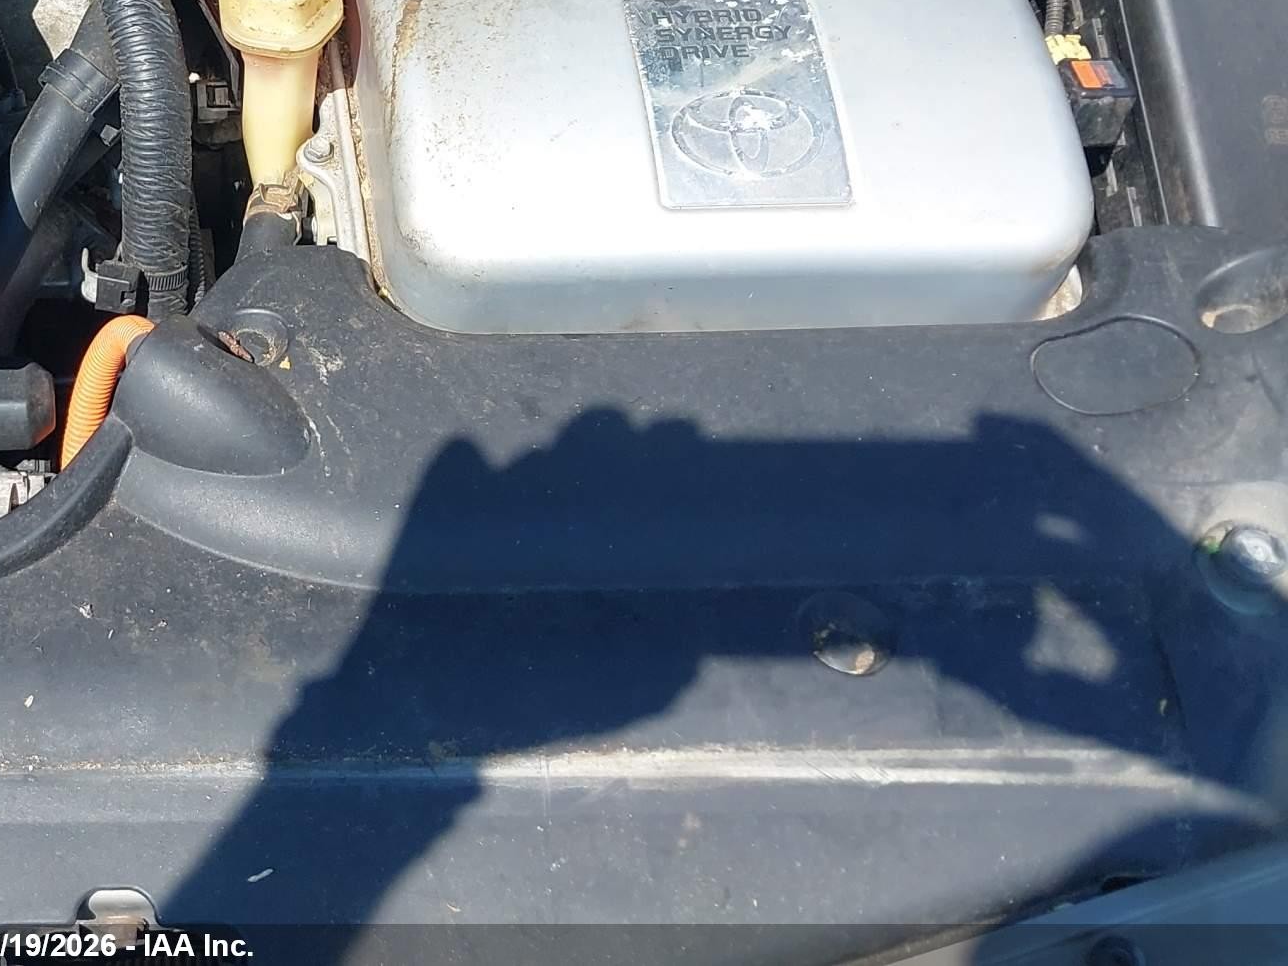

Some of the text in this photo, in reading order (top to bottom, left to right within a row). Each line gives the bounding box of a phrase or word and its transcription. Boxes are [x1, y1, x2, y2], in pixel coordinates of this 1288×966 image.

[651, 8, 761, 25] HYBRID
[655, 25, 792, 44] SYNERGY
[658, 44, 750, 60] DRIVE
